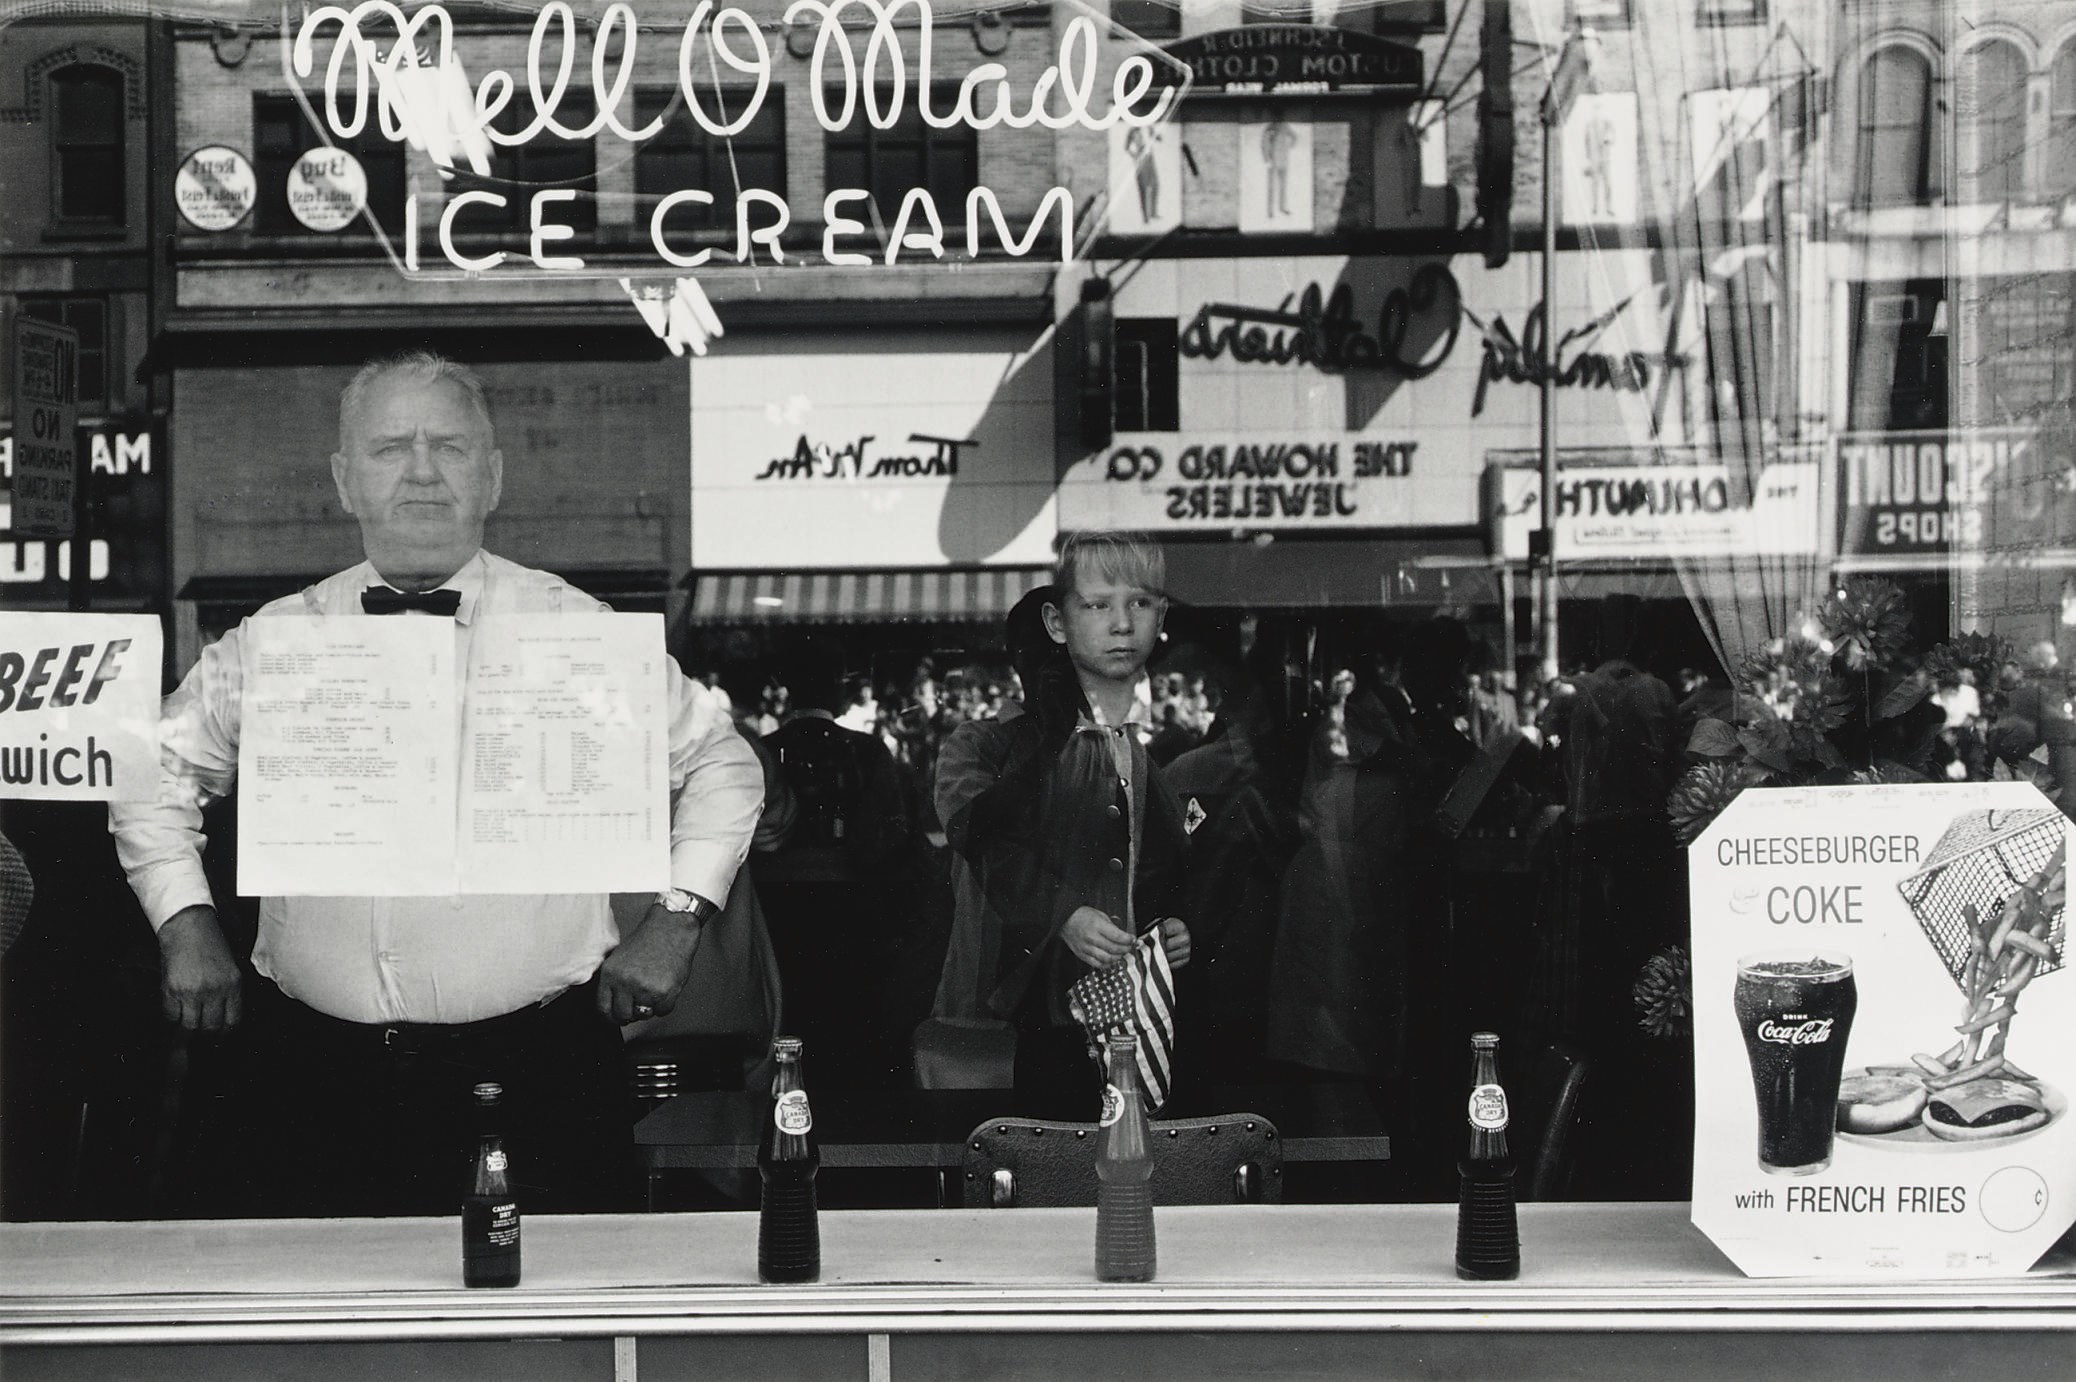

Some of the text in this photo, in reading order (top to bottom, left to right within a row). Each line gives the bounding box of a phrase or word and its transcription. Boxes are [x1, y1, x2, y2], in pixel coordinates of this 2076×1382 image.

[293, 0, 1173, 146] Mell O Made
[405, 187, 1075, 272] ICE CREAM
[0, 638, 133, 715] BEEF
[0, 732, 113, 787] wich
[1717, 835, 1921, 867] CHEESEBURGER
[1766, 884, 1864, 924] COKE
[1782, 1013, 1809, 1021] DRINK
[1735, 1185, 1967, 1214] with FRENCH FRIES
